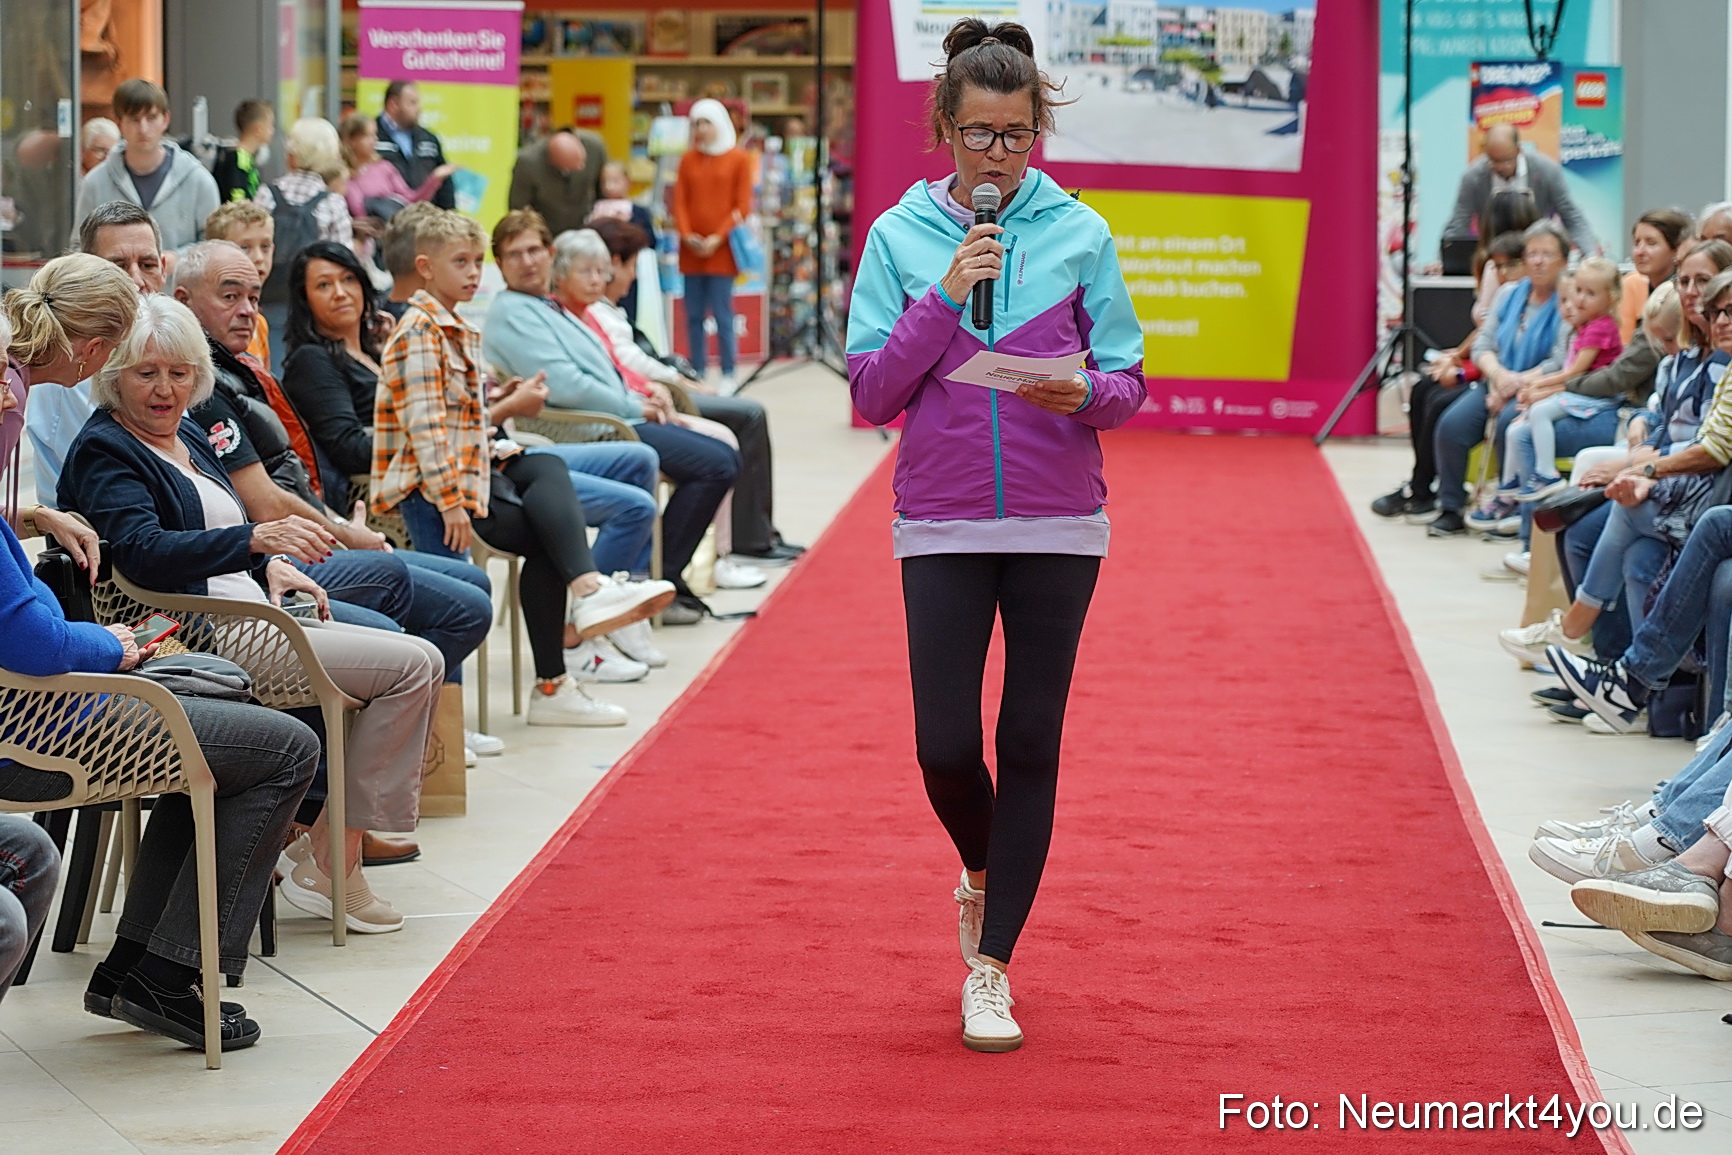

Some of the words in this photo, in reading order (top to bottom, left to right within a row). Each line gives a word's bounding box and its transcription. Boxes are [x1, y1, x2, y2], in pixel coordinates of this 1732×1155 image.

[368, 28, 477, 49] Verschenken
[478, 29, 506, 49] Sie
[402, 50, 505, 71] Gutscheine!
[1138, 237, 1160, 253] an
[1163, 235, 1216, 254] einem
[1219, 235, 1246, 254] Ort
[1121, 257, 1192, 275] Workout
[1195, 258, 1261, 276] machen
[1180, 280, 1248, 298] buchen.
[985, 371, 1035, 384] NeuerMar
